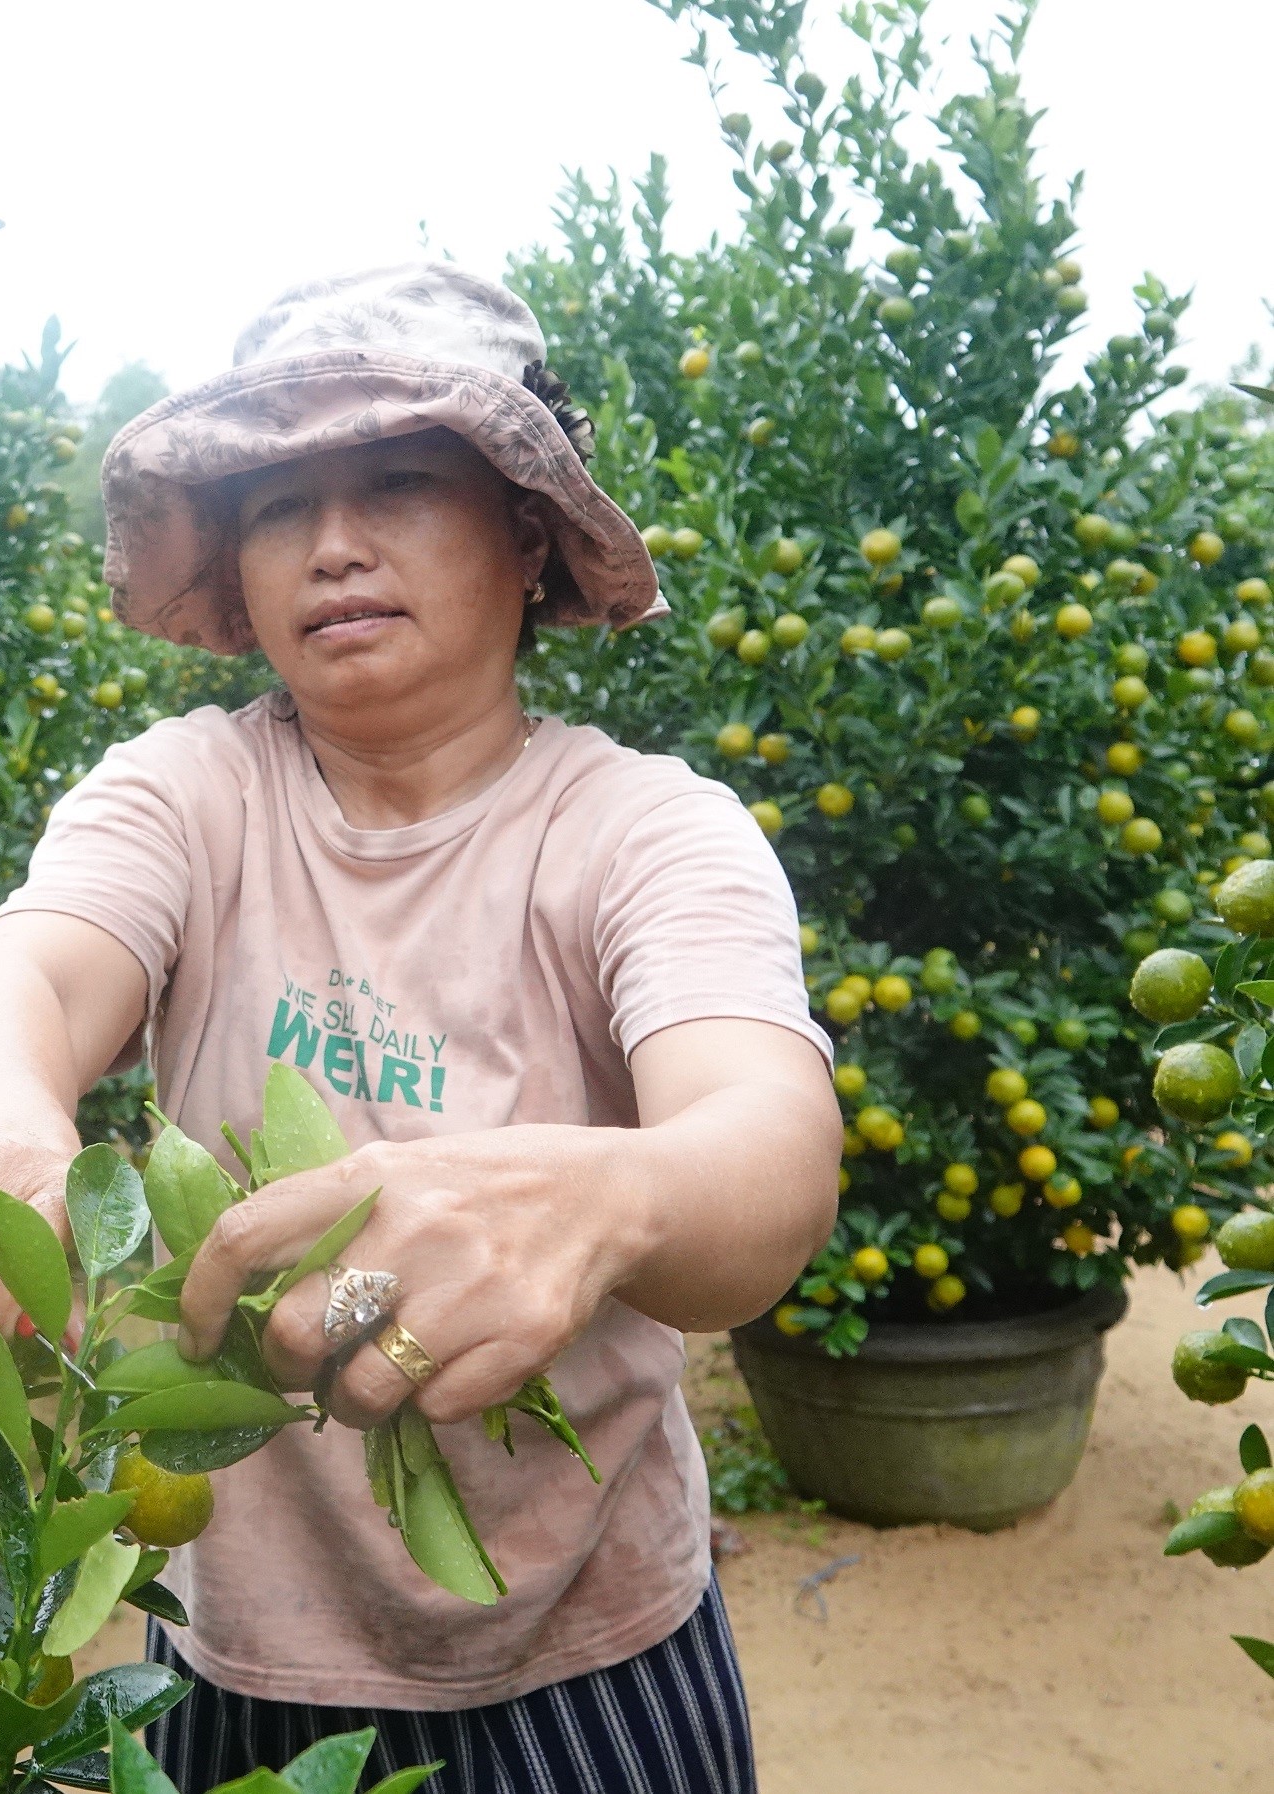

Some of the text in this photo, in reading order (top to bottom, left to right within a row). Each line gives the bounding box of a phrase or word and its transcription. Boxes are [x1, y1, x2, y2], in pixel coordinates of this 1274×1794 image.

[266, 997, 446, 1114] WEAR!
[283, 973, 447, 1063] WE SEL DAILY
